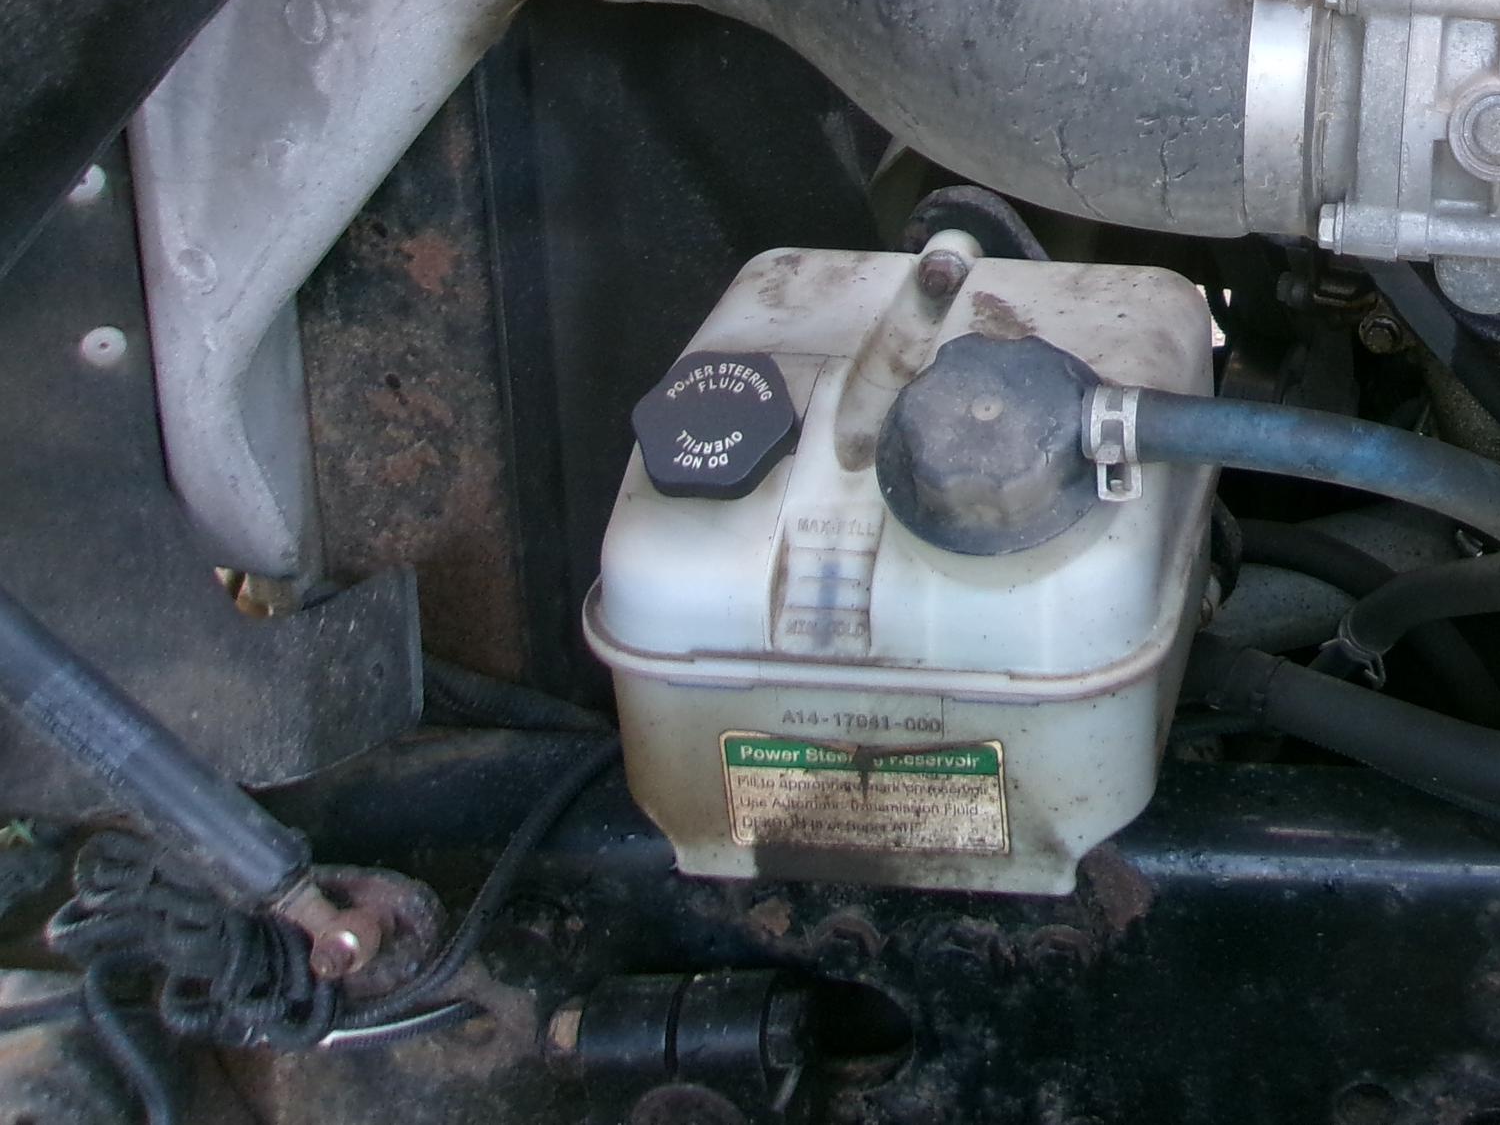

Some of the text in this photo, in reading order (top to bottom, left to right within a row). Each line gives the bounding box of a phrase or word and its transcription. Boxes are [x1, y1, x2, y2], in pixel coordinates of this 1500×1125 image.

[666, 363, 773, 401] POWER STEERING
[698, 377, 745, 393] FLUID
[676, 429, 743, 455] OVERFILL
[673, 452, 729, 469] DO NOT
[740, 744, 801, 763] Power
[805, 746, 883, 768] Steerg
